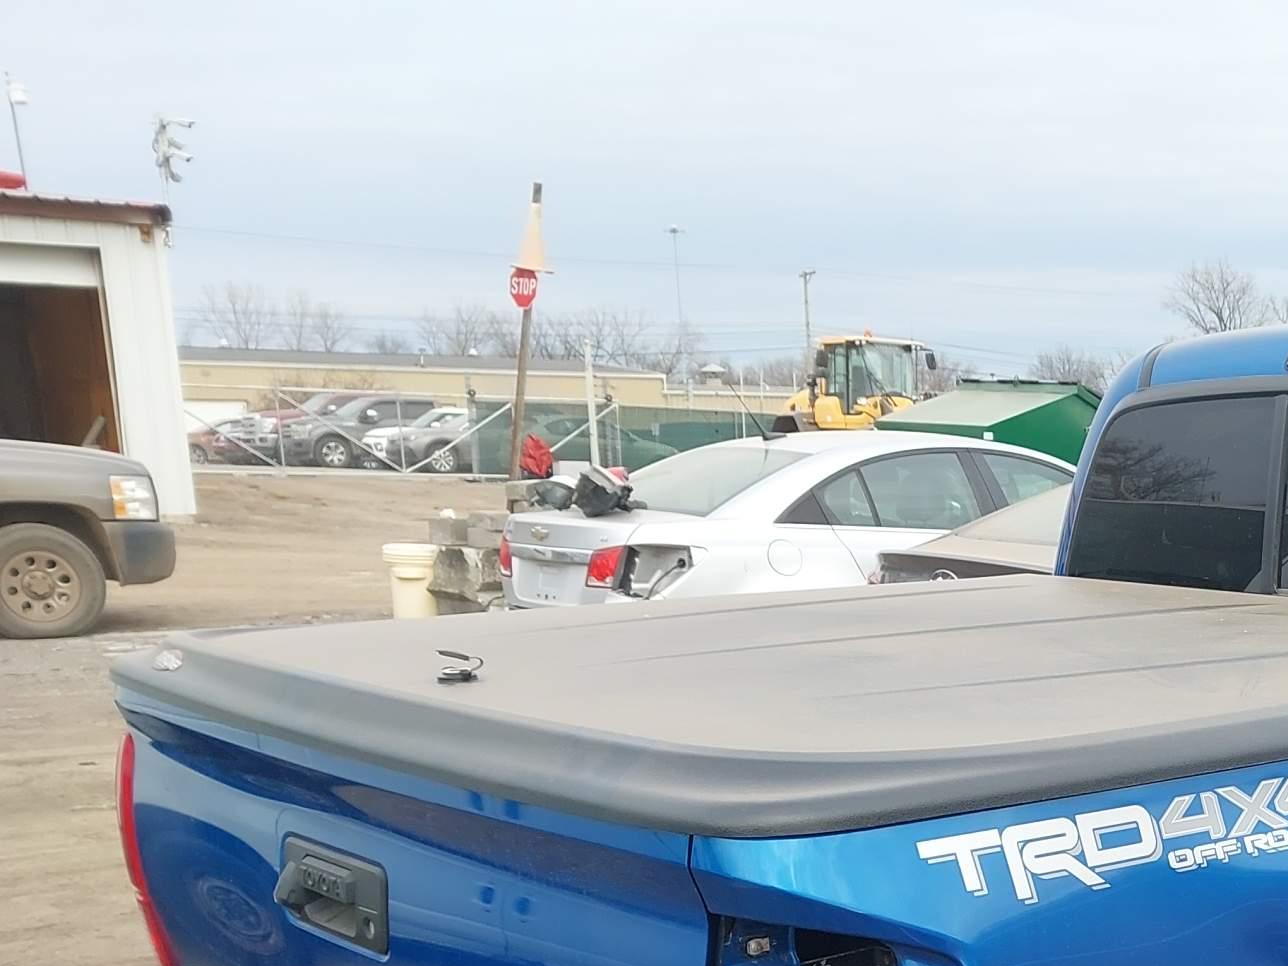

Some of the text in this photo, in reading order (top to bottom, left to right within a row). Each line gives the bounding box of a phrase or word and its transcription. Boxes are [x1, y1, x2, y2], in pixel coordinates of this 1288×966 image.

[511, 277, 537, 295] STOP
[915, 804, 1164, 905] TRD
[1167, 838, 1242, 872] OFF
